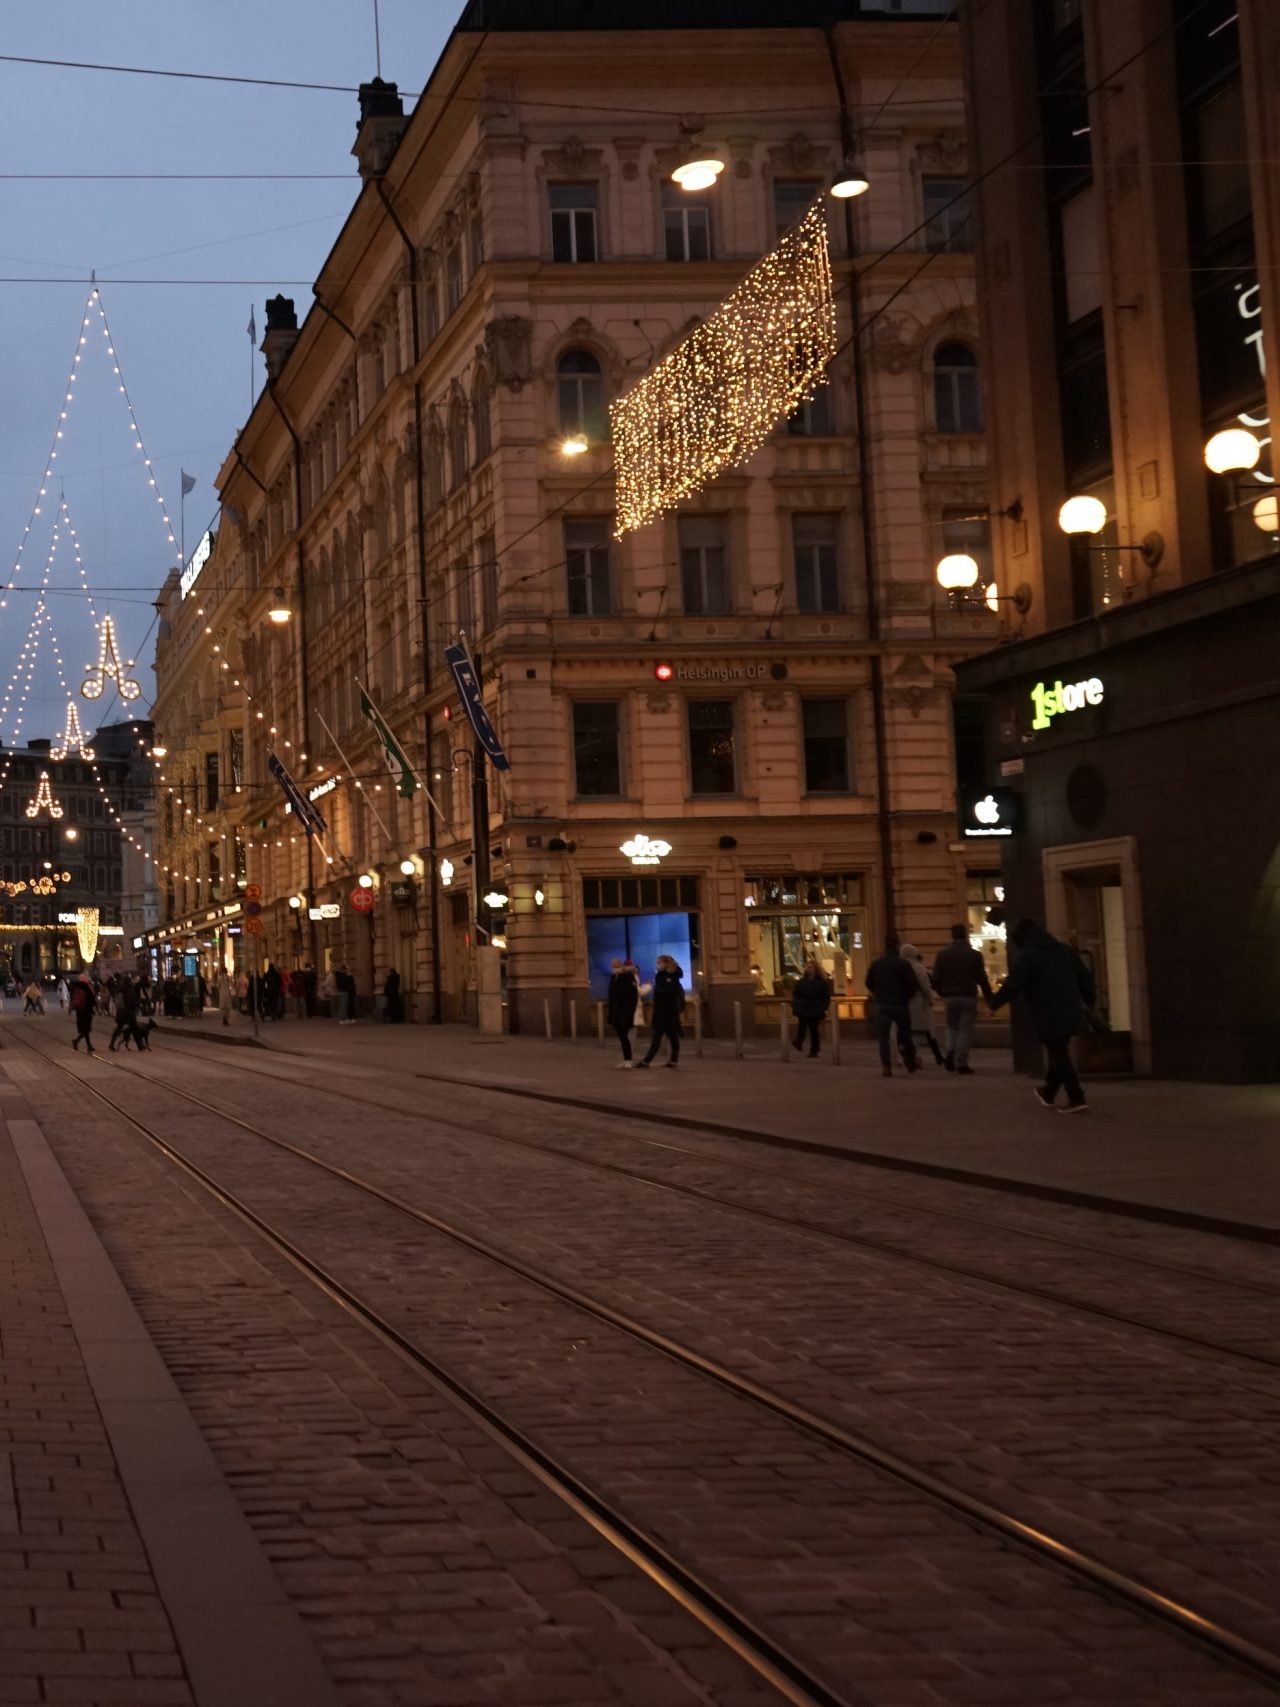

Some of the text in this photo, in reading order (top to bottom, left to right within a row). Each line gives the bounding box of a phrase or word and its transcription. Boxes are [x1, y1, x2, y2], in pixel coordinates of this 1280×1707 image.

[677, 664, 766, 682] Helsingin OP
[1031, 678, 1104, 730] 1store
